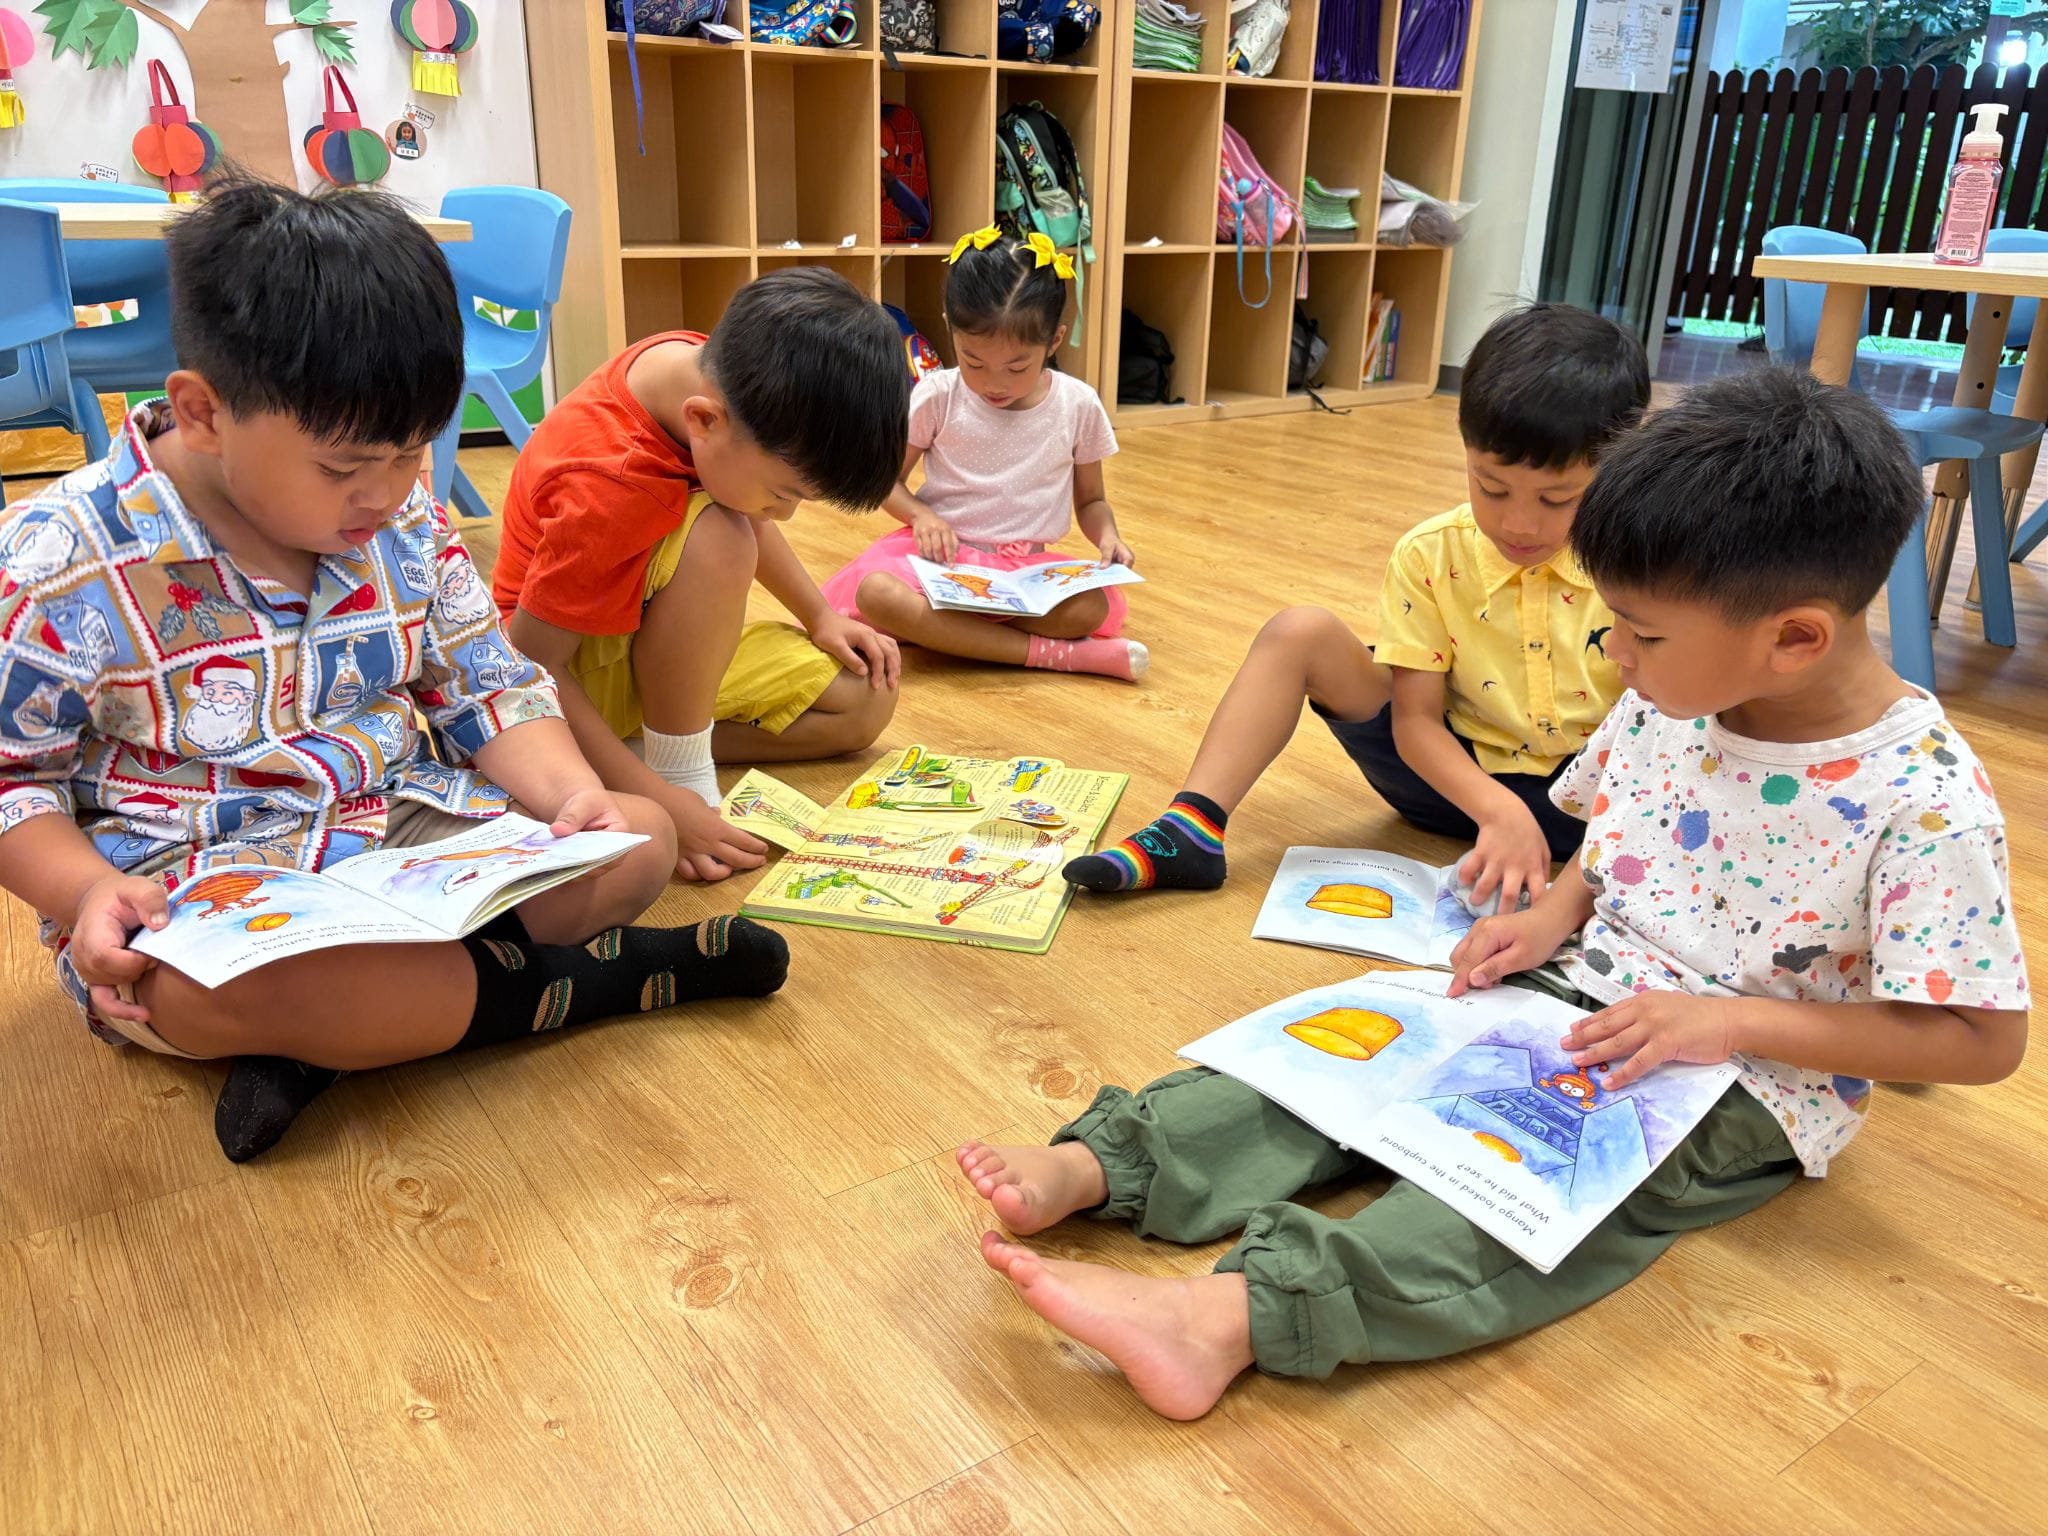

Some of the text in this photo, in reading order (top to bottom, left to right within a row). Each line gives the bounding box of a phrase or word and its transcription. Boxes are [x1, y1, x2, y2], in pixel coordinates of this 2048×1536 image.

[403, 566, 425, 576] EGG
[406, 575, 428, 585] NOG
[1361, 862, 1390, 871] buttery
[248, 931, 301, 947] anyway.
[262, 936, 311, 951] buttery
[226, 949, 259, 967] cake!
[1380, 1134, 1537, 1236] Mango looked in the cupboard.
[1456, 1162, 1551, 1224] What did he see?
